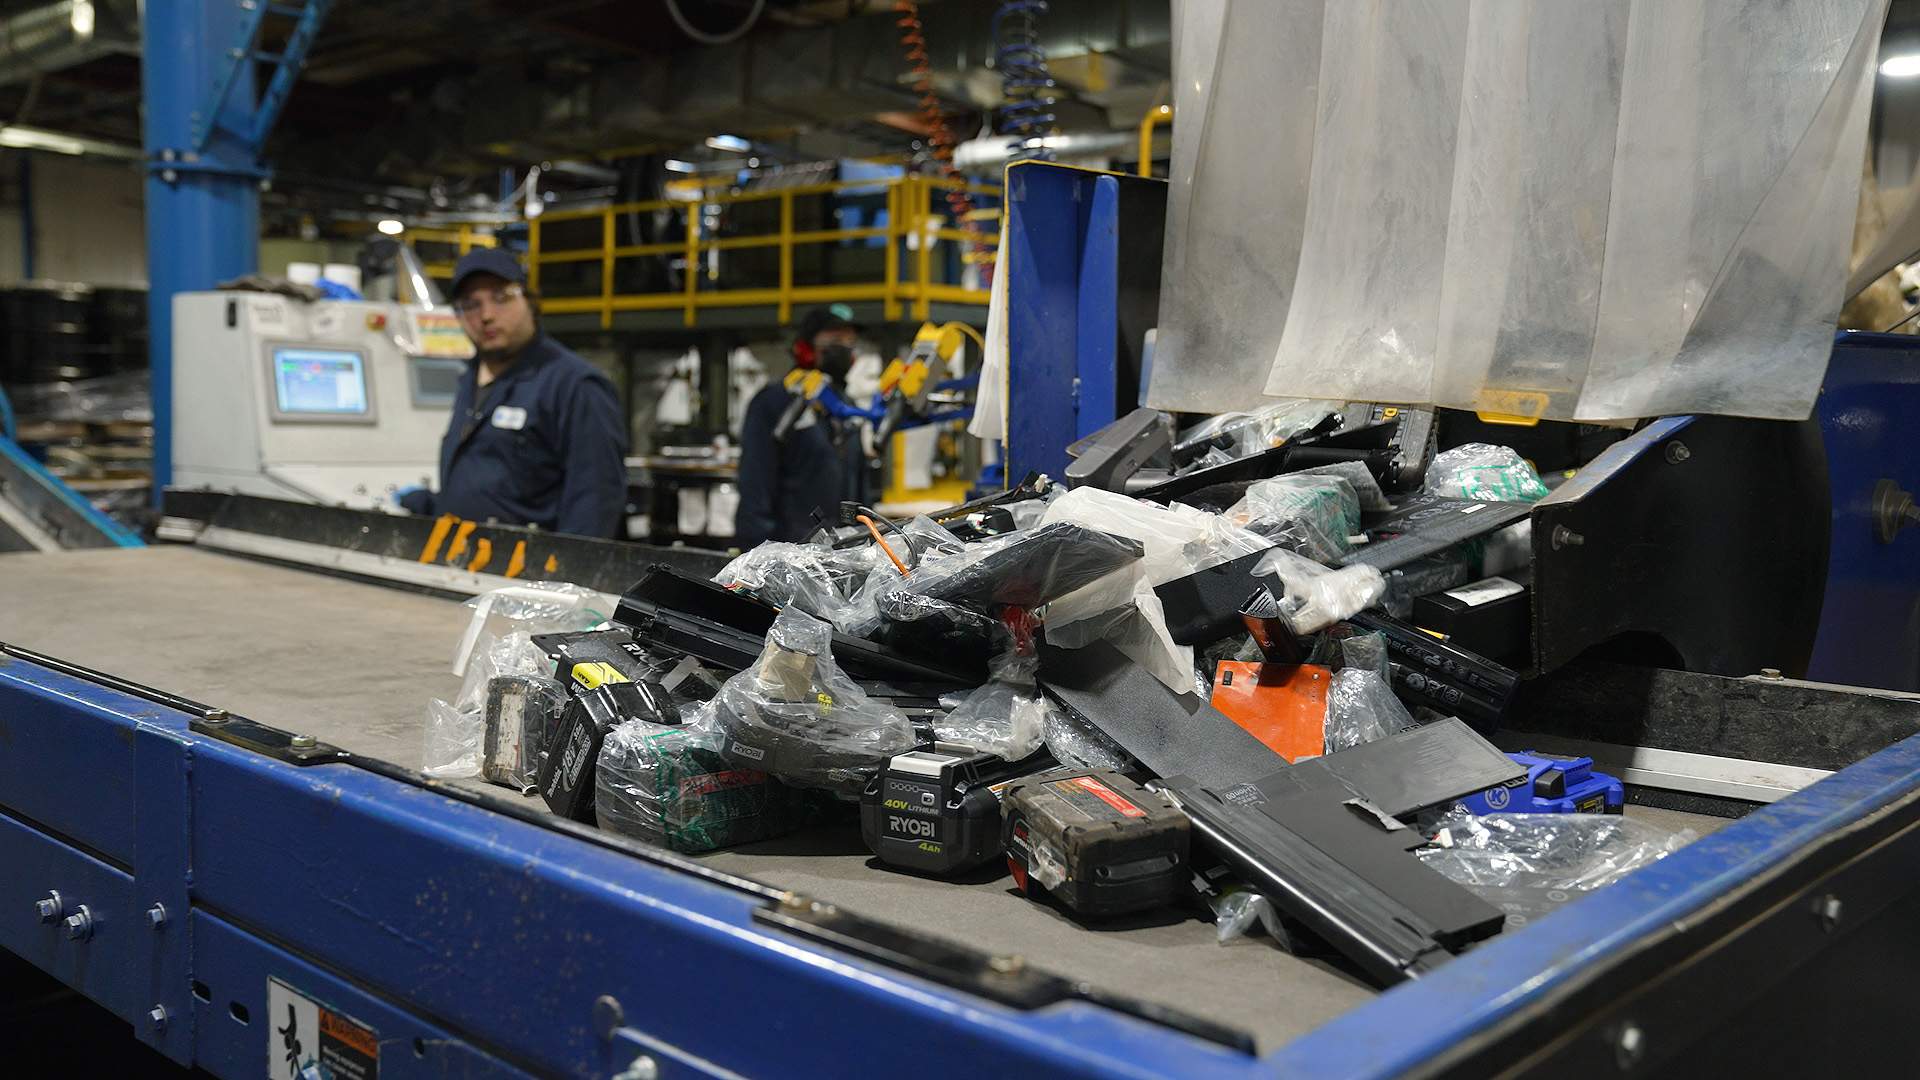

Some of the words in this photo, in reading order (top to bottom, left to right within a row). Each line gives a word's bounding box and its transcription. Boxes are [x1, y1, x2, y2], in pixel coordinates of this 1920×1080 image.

[733, 743, 762, 759] RYOBI
[884, 799, 908, 810] 40V
[908, 804, 939, 815] LITHIUM
[889, 815, 935, 838] RYOBI
[918, 842, 941, 853] 4Ah
